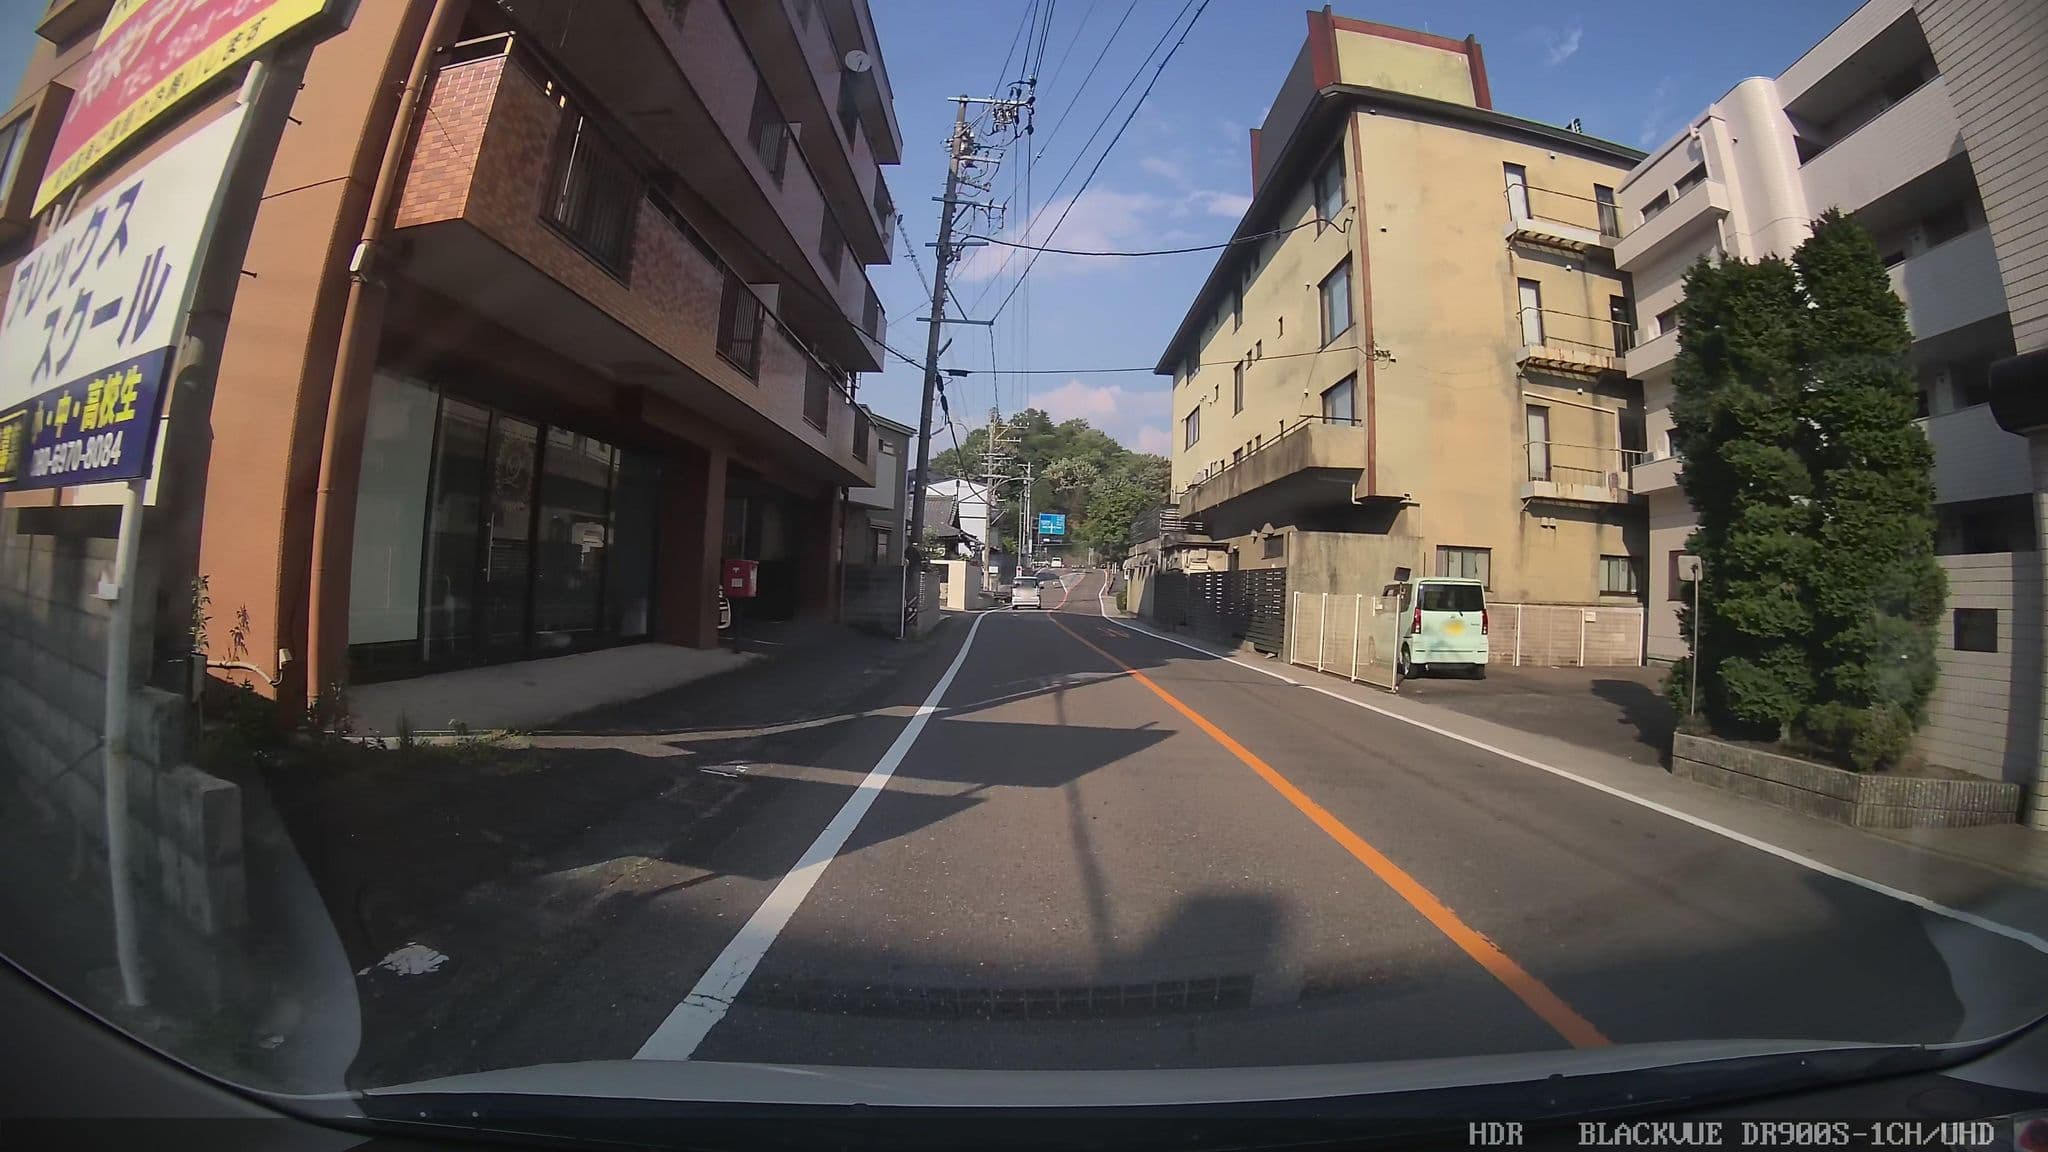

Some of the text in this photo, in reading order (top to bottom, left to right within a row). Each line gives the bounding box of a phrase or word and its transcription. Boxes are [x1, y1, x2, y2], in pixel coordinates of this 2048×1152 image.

[6, 179, 144, 329] アレックス
[31, 245, 172, 386] スクール
